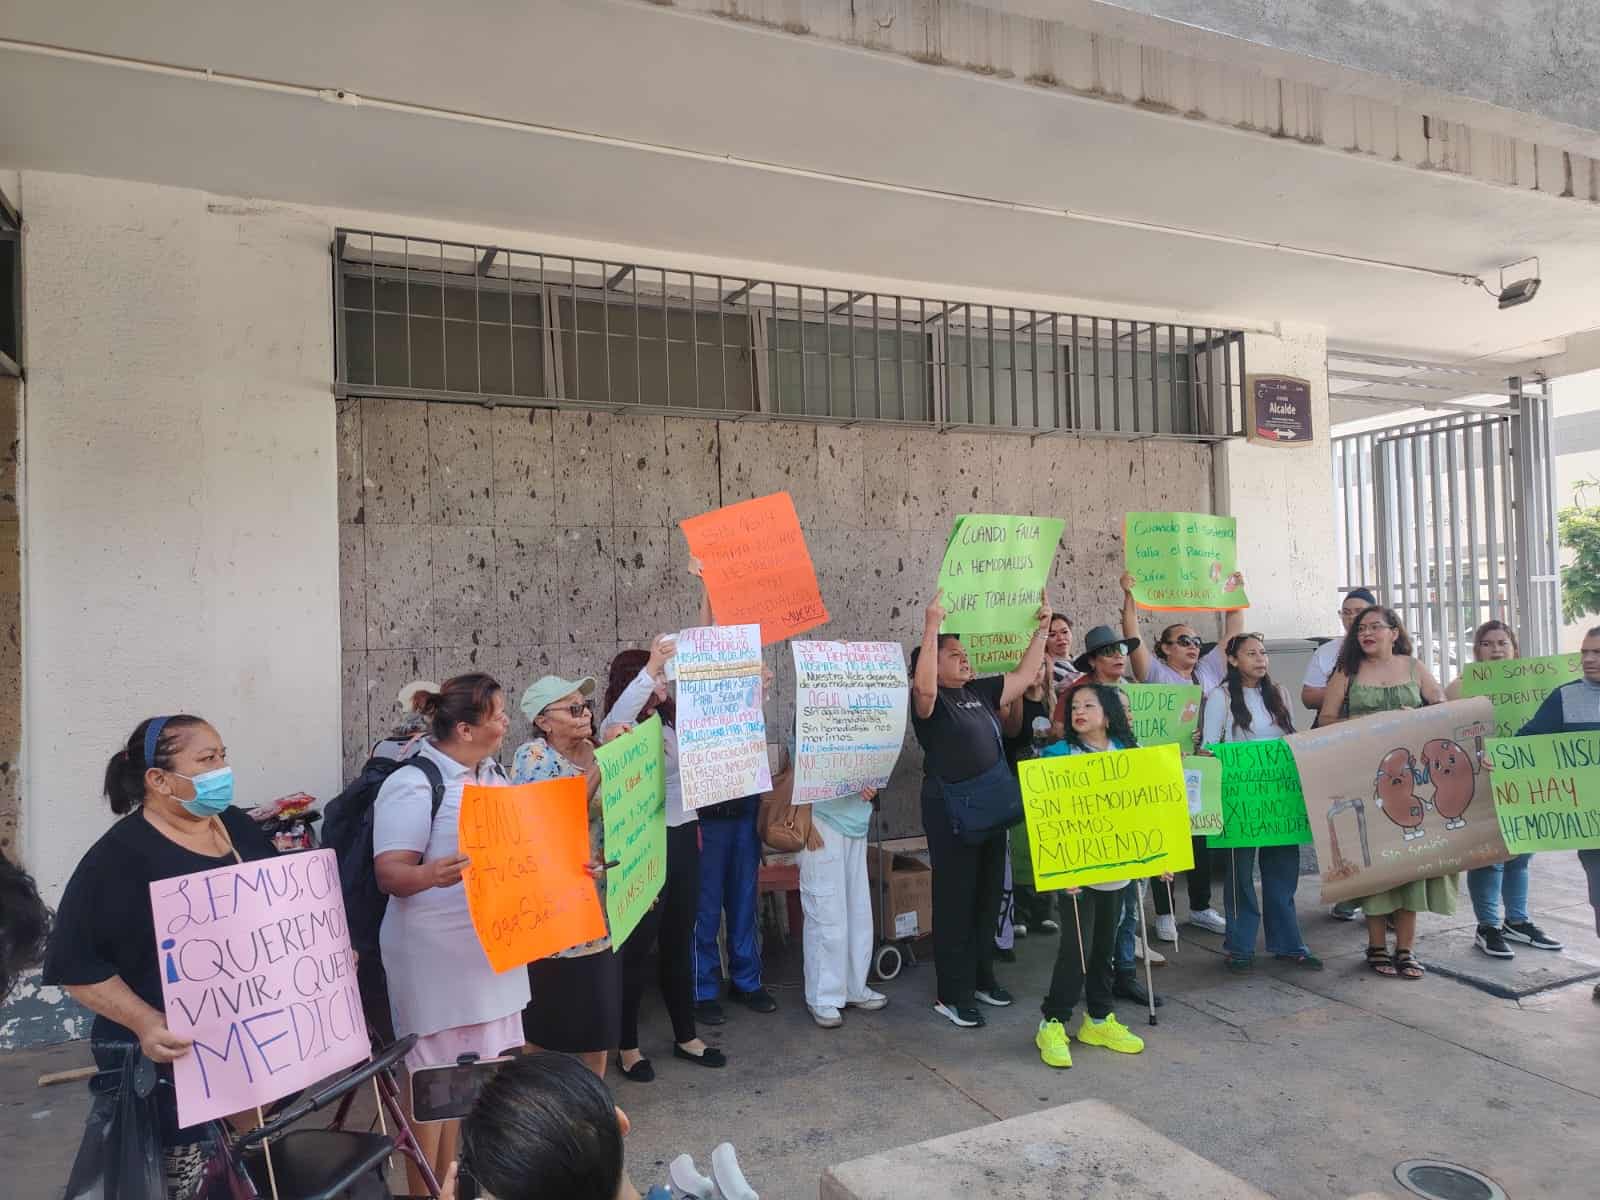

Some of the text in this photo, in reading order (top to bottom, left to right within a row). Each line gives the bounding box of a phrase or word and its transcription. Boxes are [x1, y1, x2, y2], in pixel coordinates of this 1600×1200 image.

[1269, 402, 1296, 415] Alcalde
[963, 523, 1040, 545] CUANDO FALLA
[1134, 520, 1180, 536] Cuando
[1186, 521, 1197, 534] el
[1169, 545, 1179, 555] el
[949, 560, 964, 577] LA
[948, 591, 979, 614] SUFRE
[985, 590, 1006, 609] TODA
[1473, 667, 1493, 681] NO
[1503, 663, 1558, 680] SOMOS
[1158, 692, 1177, 711] DE
[1026, 765, 1090, 794] Clinica
[1030, 797, 1061, 818] SIN
[1072, 783, 1182, 816] HEMODIALISIS
[1496, 776, 1578, 808] NO HAY
[1036, 815, 1114, 842] ESTAMOS
[1038, 828, 1163, 869] MURIENDO
[161, 861, 304, 934] LEMUS,
[171, 974, 282, 1026] VIVIR,
